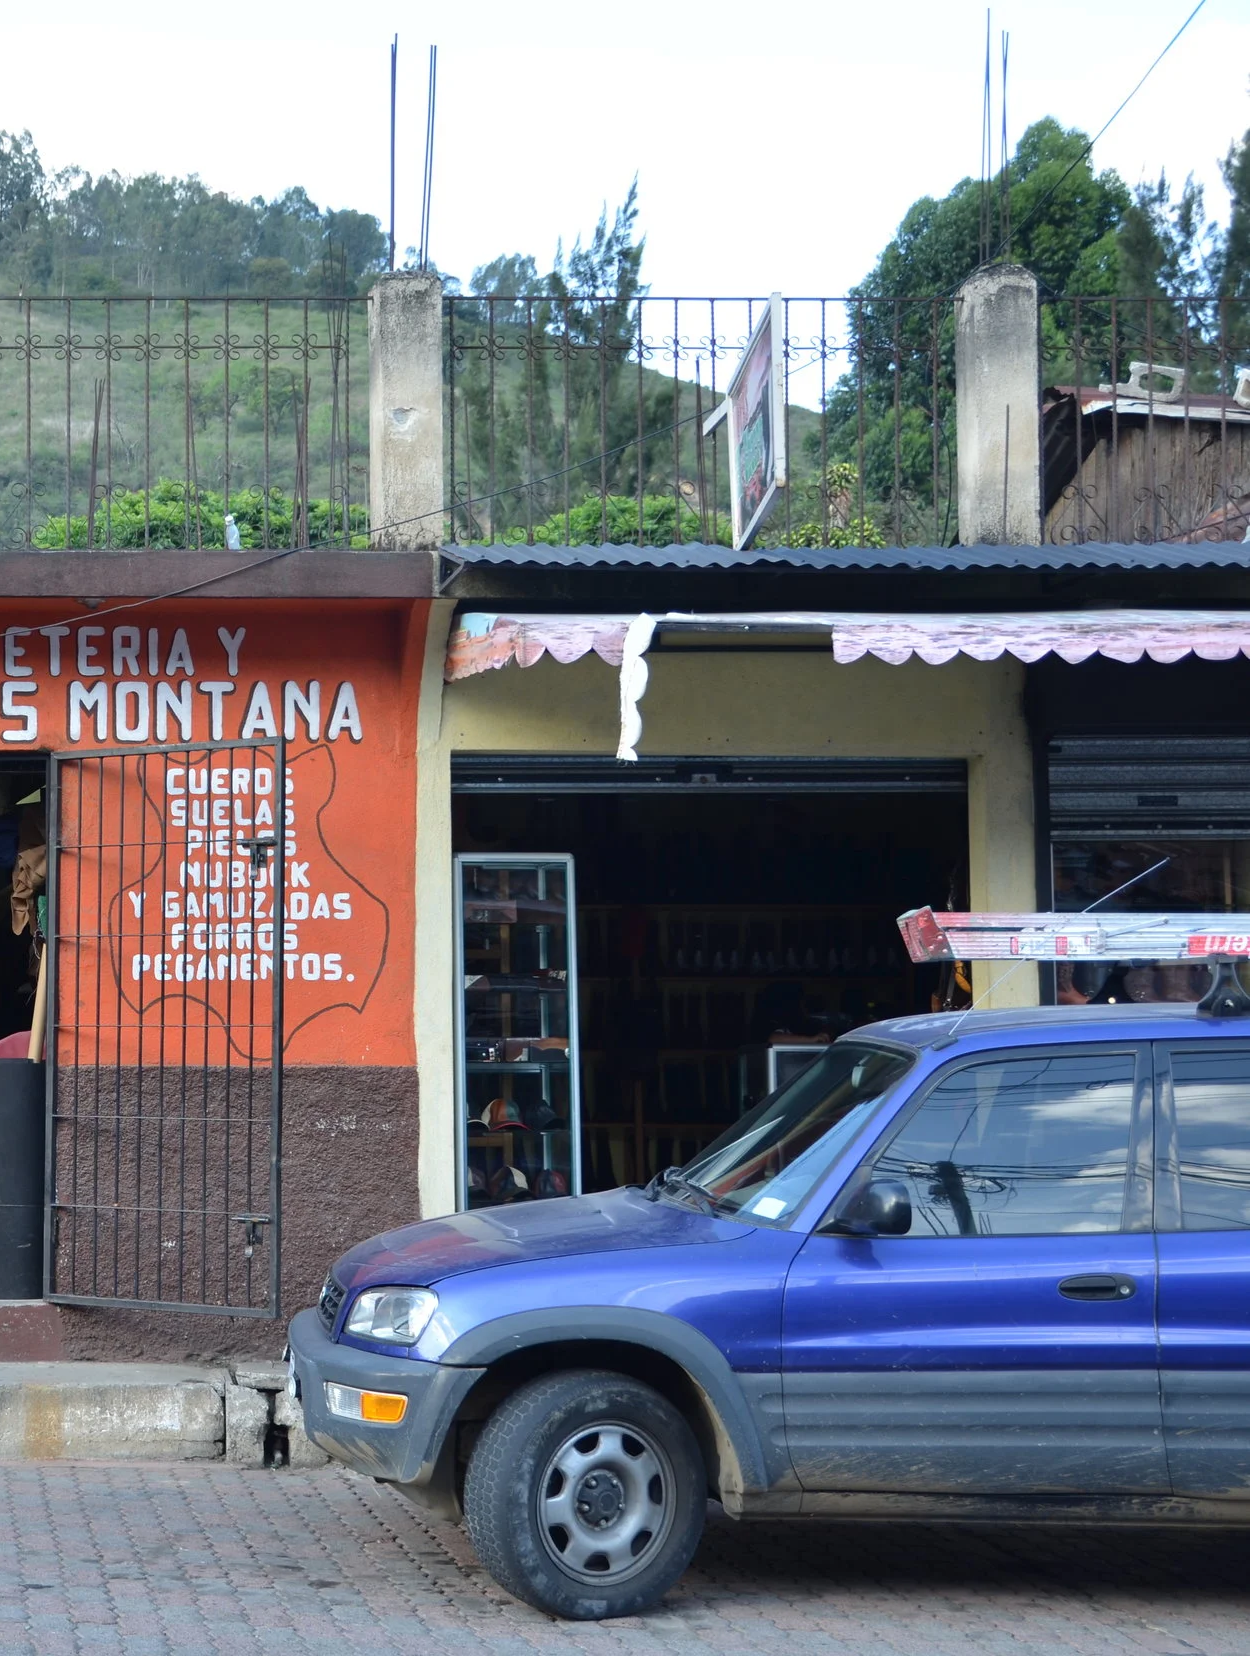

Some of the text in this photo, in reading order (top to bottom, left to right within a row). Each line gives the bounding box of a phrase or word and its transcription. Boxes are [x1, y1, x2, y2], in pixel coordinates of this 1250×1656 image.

[217, 626, 246, 677] Y
[68, 679, 363, 742] MONTANA
[166, 767, 295, 796] CUEROS
[170, 799, 296, 828] SUELAS
[128, 891, 146, 919] Y
[171, 922, 299, 951] FORROS
[1204, 936, 1250, 954] ern
